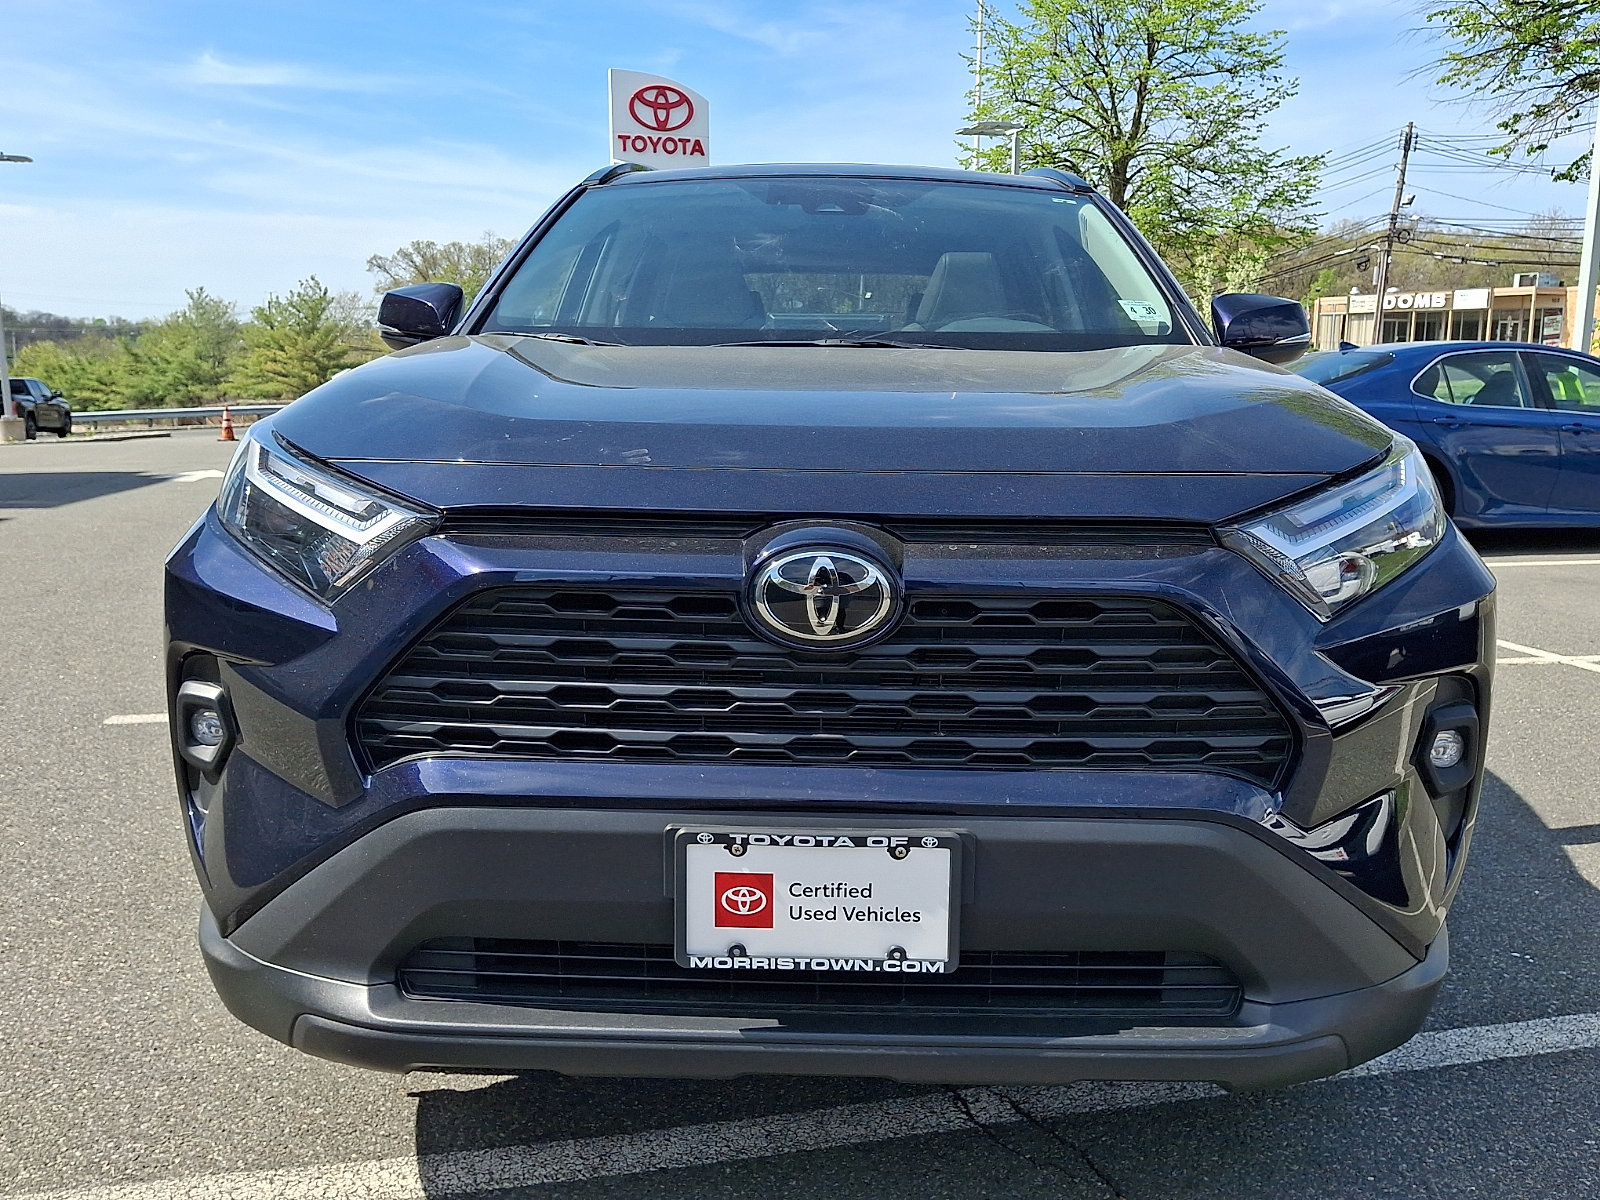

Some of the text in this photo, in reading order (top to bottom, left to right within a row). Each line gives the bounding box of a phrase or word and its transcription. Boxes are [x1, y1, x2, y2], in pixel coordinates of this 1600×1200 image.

[617, 134, 706, 156] TOYOTA
[1382, 292, 1447, 310] DOMB
[729, 833, 909, 848] TOYOTA OF
[788, 882, 873, 899] Certified
[788, 905, 922, 923] Used Vehicles
[690, 956, 945, 974] MORRISTOWN.COM
